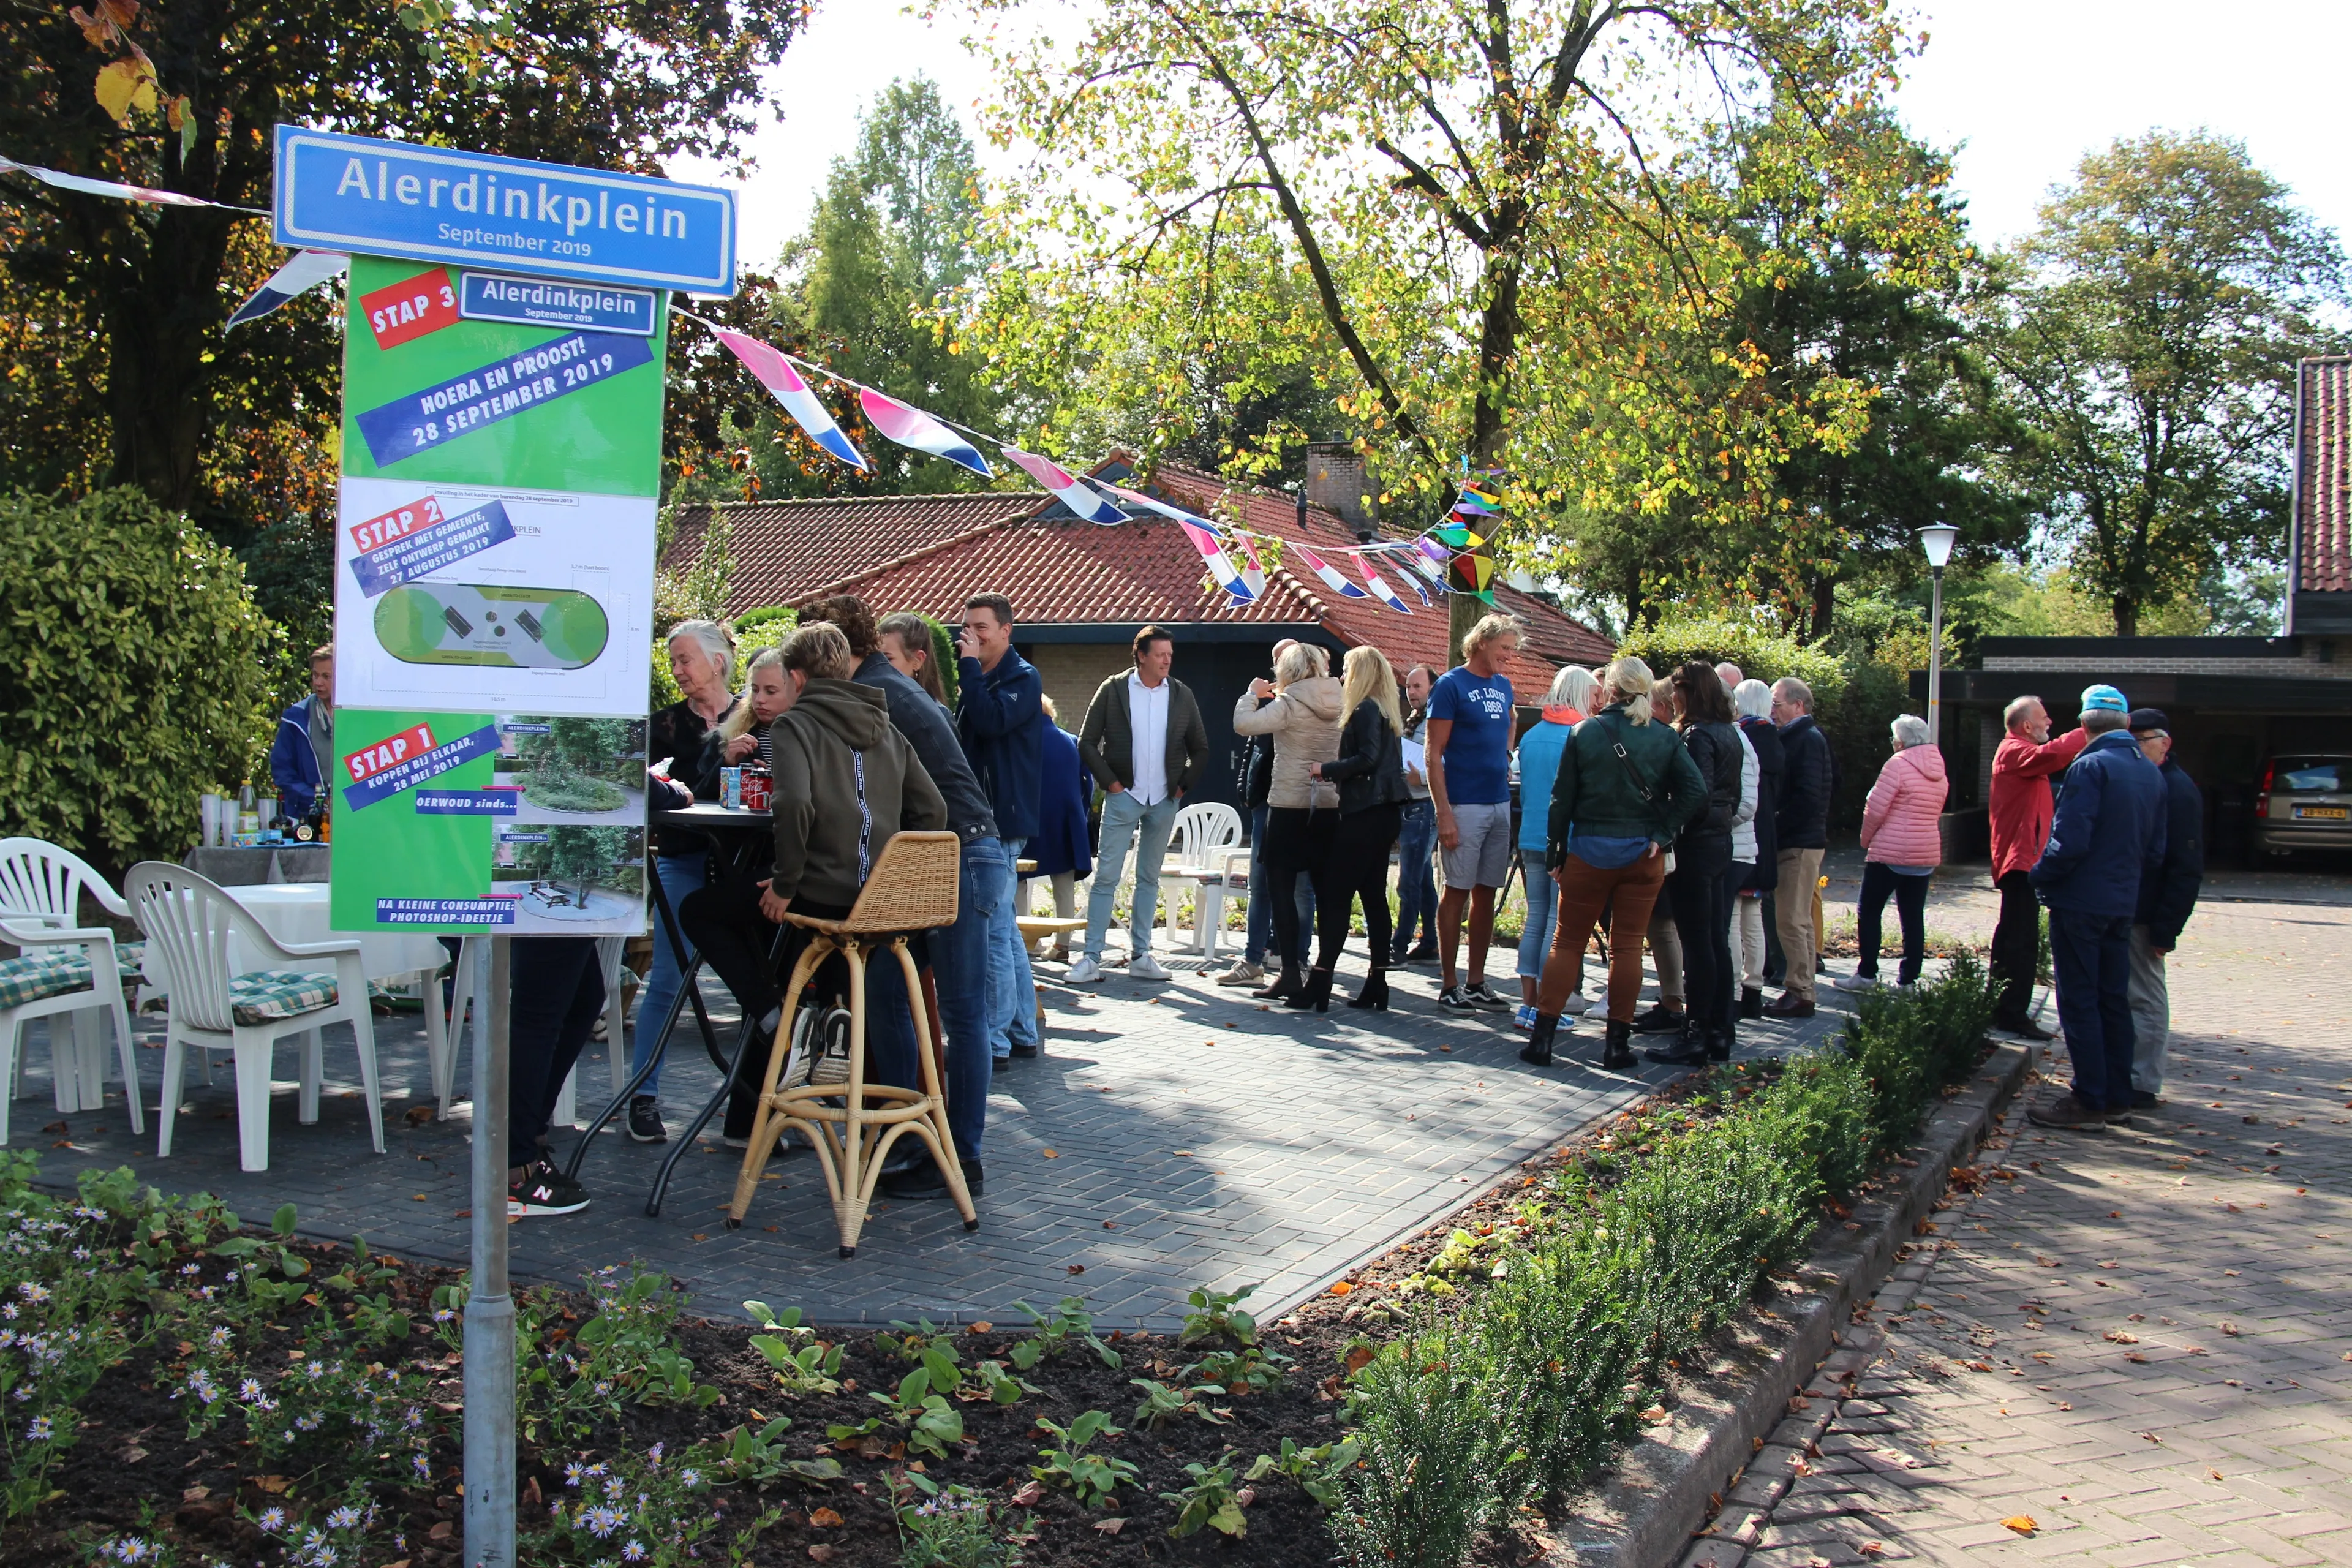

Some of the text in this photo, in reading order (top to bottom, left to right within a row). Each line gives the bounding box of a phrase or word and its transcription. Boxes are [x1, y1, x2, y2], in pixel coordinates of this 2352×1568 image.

[336, 156, 687, 239] Alerdinkplein
[437, 222, 592, 257] September 2019
[372, 285, 456, 334] STAP 3
[482, 281, 636, 314] Alerdinkplein
[524, 307, 593, 323] September 2019
[421, 336, 587, 415] HOERA EN PROOST!
[412, 353, 614, 448] 28 SEPTEMBER 2019
[358, 500, 440, 550] STAP 2
[372, 511, 486, 564] GESPREK MET GEMEENTE,
[377, 522, 490, 576] ZELF ONTWERP GEMAAKT
[390, 537, 489, 585] 27 AUGUSTUS 2019
[1468, 687, 1506, 703] ST. LOUIS
[1482, 701, 1503, 713] 1968
[351, 727, 432, 778] STAP 1
[368, 737, 475, 789] KOPPEN BIJ ELKAAR,
[393, 755, 460, 793] 28 MEI 2019
[417, 797, 517, 809] OERWOUD sinds...
[377, 900, 515, 911] NA KLEINE CONSUMPTIE:
[390, 912, 503, 923] PHOTOSHOP-IDEETJE
[532, 1185, 553, 1202] N
